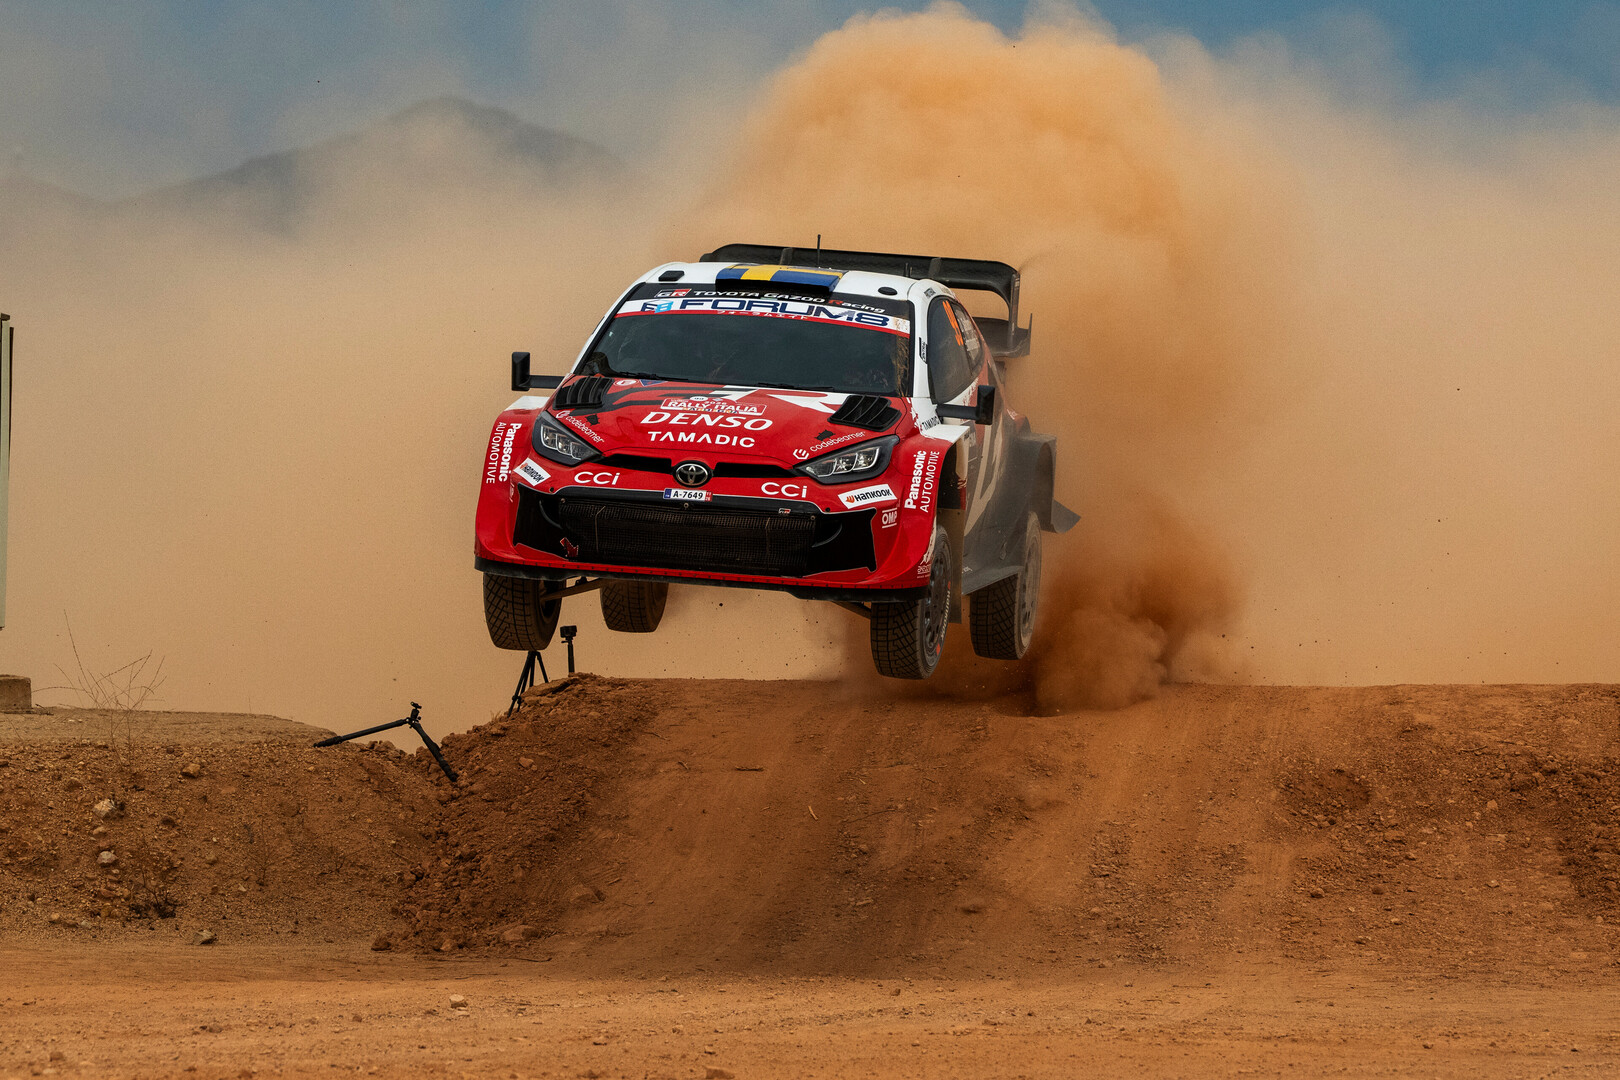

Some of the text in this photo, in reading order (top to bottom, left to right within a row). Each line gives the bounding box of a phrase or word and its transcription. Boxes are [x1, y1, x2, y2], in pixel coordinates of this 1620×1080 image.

[680, 299, 890, 326] FORUM8
[764, 292, 825, 303] GAZOO
[829, 299, 886, 313] Racing
[668, 401, 710, 409] RALLY
[715, 404, 758, 413] ITALIA
[641, 412, 773, 431] DENSO
[648, 431, 756, 448] TAMADIC
[810, 432, 866, 453] codebeamer
[486, 421, 507, 484] AUTOMOTIVE
[499, 423, 522, 482] Panasonic
[904, 450, 927, 510] Panasonic
[920, 450, 940, 513] AUTOMOTIVE
[673, 491, 704, 499] A-7649
[882, 511, 898, 525] OMP
